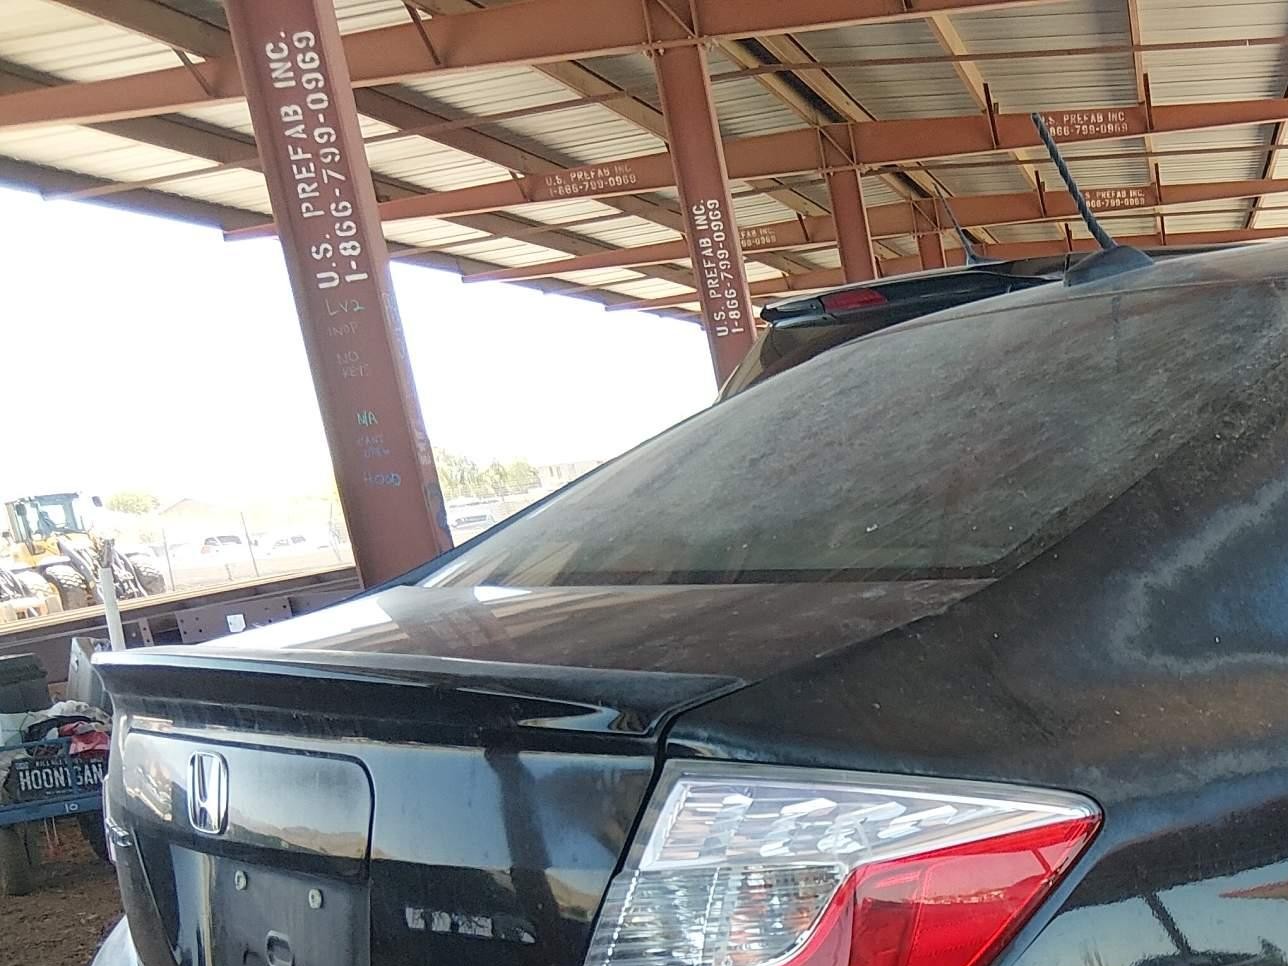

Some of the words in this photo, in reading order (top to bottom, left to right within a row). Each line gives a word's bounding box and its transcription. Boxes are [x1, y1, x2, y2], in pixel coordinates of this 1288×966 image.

[265, 31, 296, 88] INC.
[1049, 123, 1129, 137] 866-799-0969
[1063, 113, 1104, 125] PREFAB
[281, 104, 325, 218] PREFAB
[292, 31, 368, 283] 1-866-799-0969
[569, 166, 611, 182] PREFAB
[692, 199, 709, 230] INC.
[311, 233, 340, 289] U.S.
[699, 237, 722, 298] PREFAB
[706, 199, 744, 334] 1-866-799-0969
[714, 306, 730, 337] U.S.
